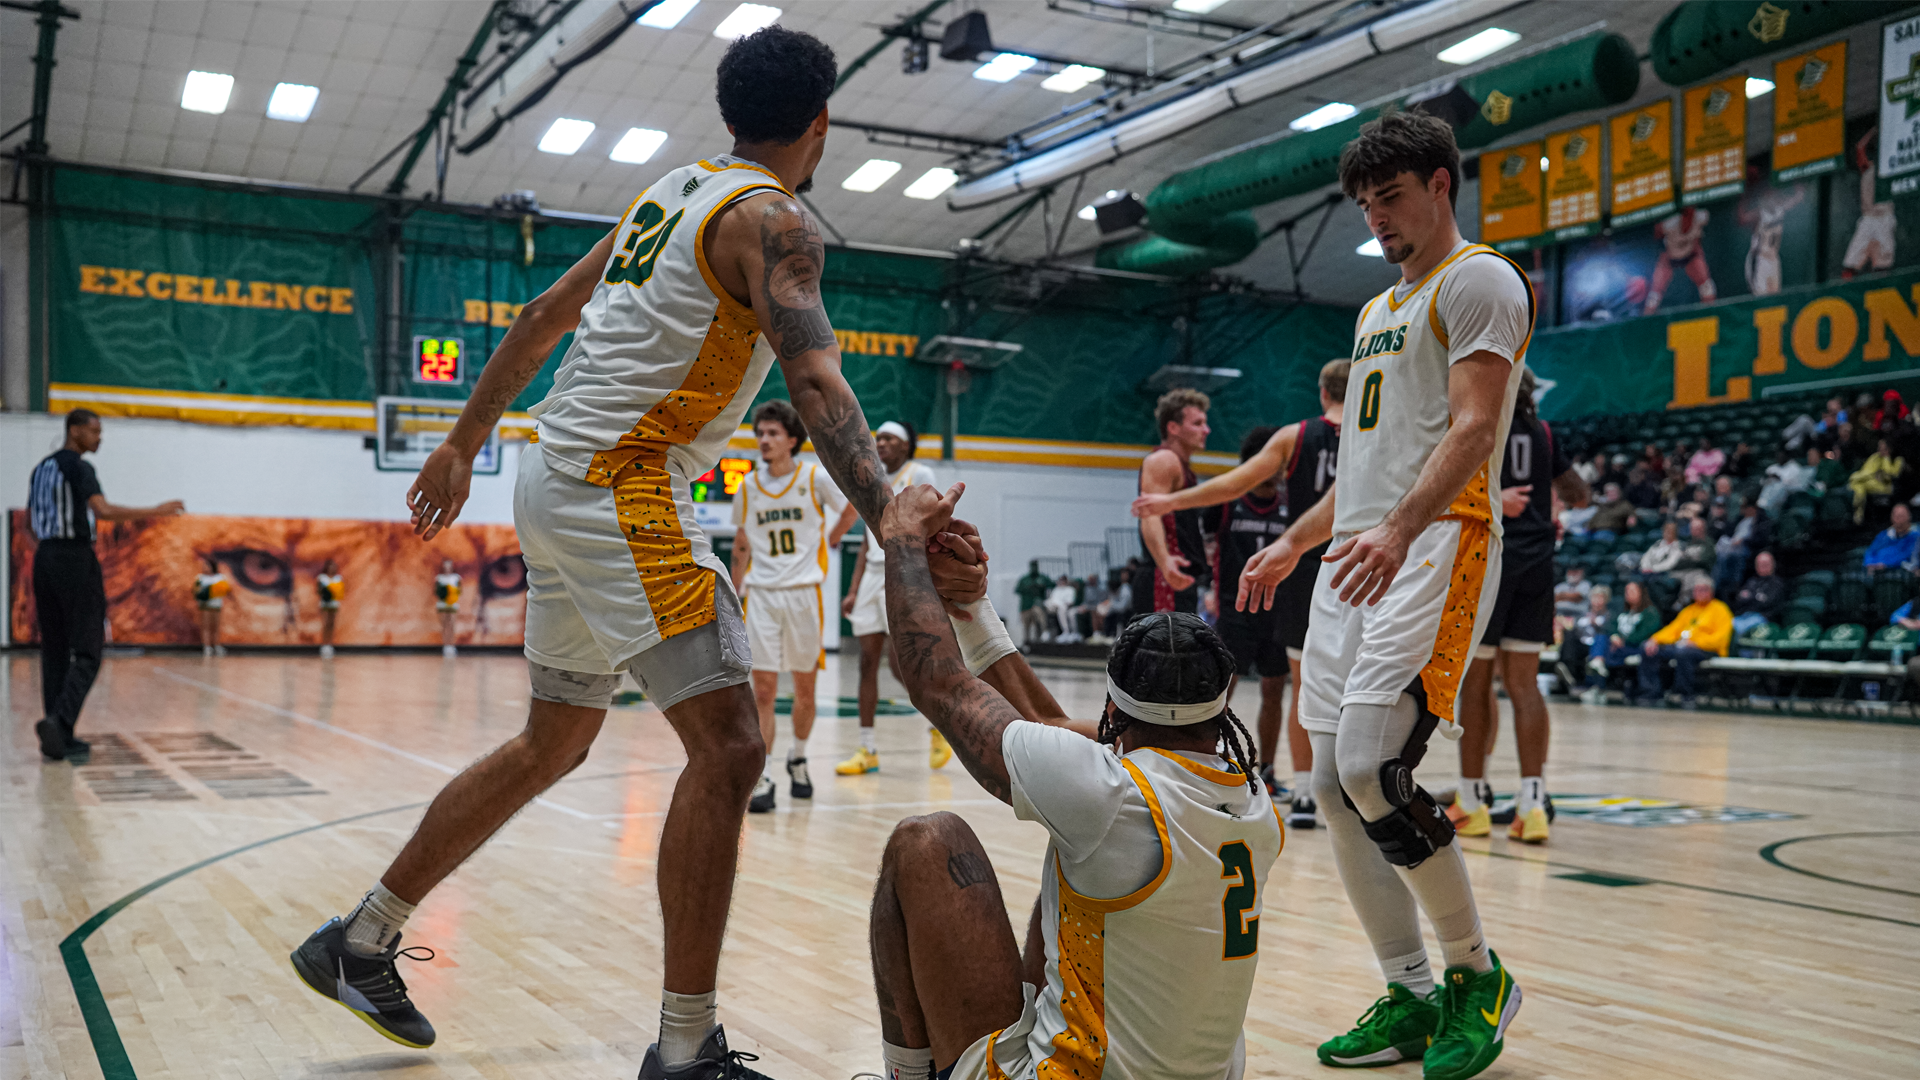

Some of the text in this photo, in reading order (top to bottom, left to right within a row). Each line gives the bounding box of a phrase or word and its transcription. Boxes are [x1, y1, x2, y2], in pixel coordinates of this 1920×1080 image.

[604, 199, 686, 290] 30
[79, 264, 354, 314] EXCELLENCE
[421, 353, 456, 382] 22
[1351, 321, 1411, 368] LIONS
[1358, 369, 1384, 432] 0
[1511, 434, 1531, 480] 0
[757, 507, 803, 525] LIONS
[769, 529, 795, 557] 10
[1217, 839, 1260, 961] 2
